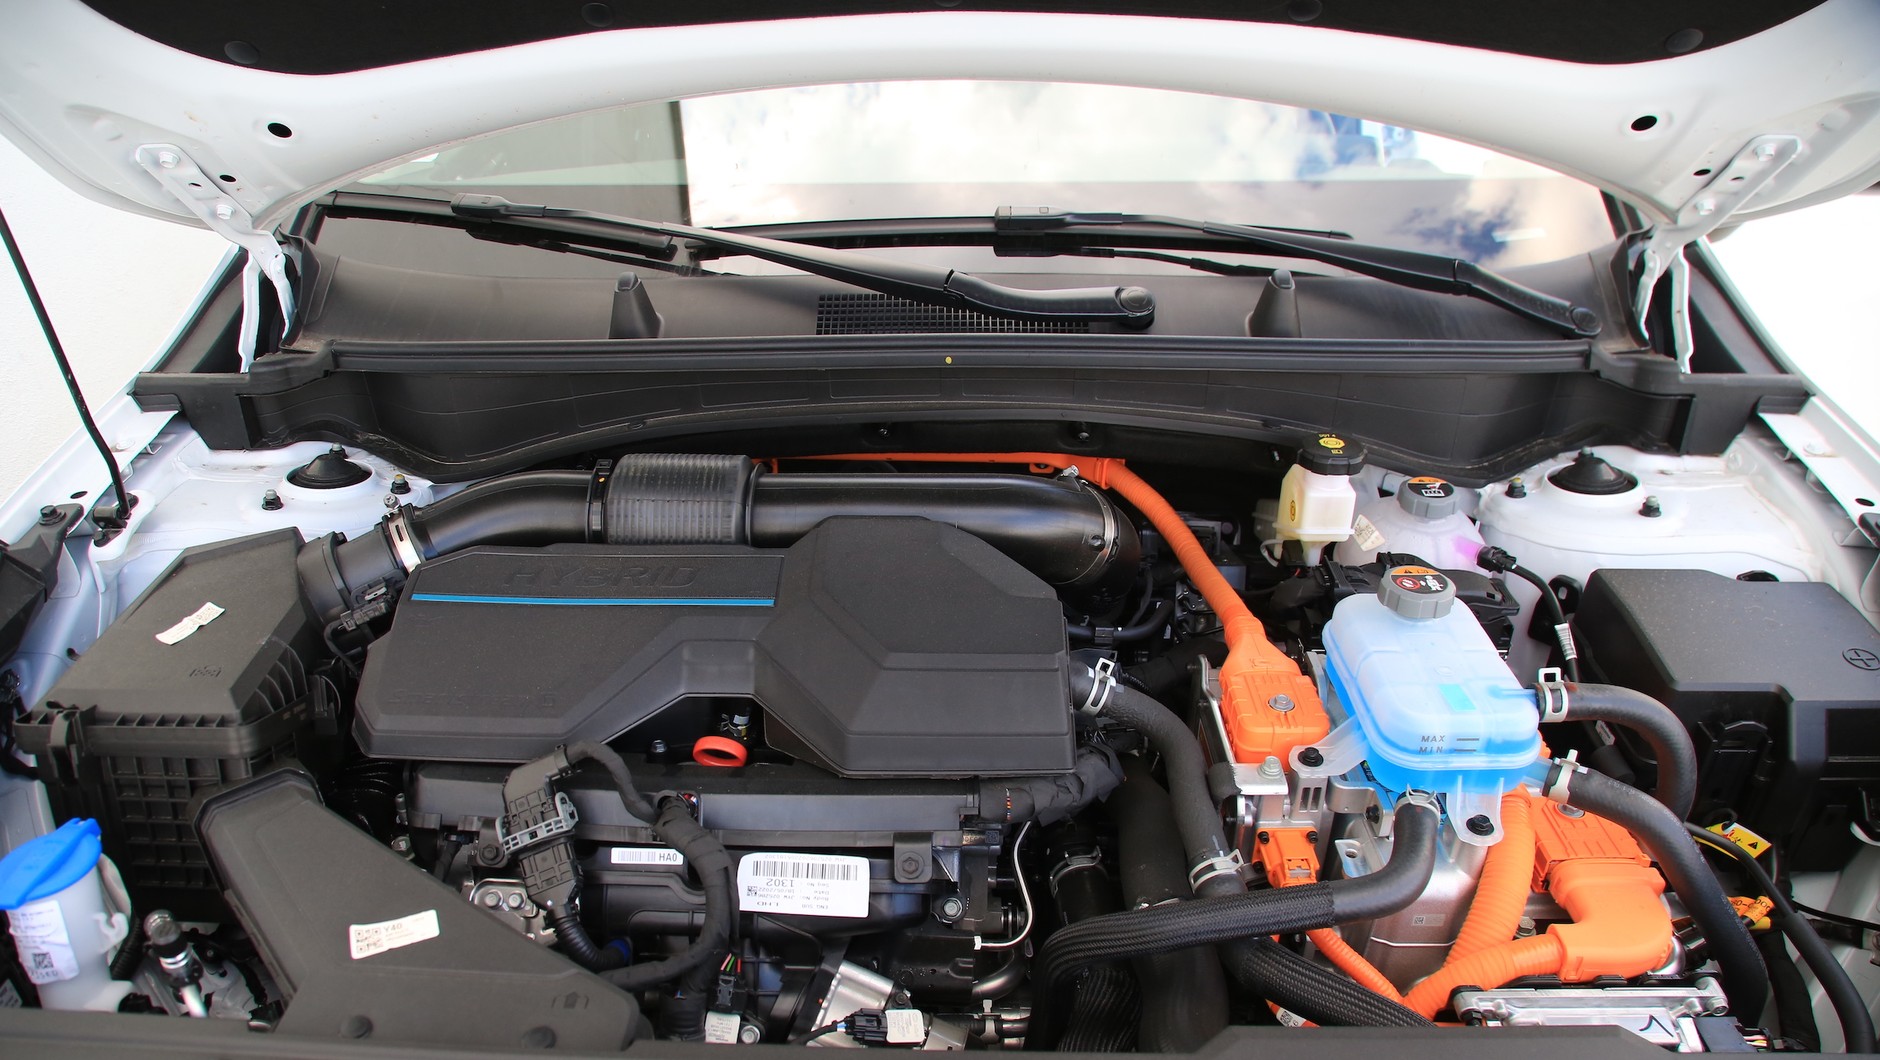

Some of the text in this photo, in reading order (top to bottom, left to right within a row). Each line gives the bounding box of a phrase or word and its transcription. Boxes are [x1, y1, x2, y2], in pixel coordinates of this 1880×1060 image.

[502, 566, 701, 589] HYBRID
[1421, 735, 1445, 743] MAX
[766, 878, 794, 887] 1302
